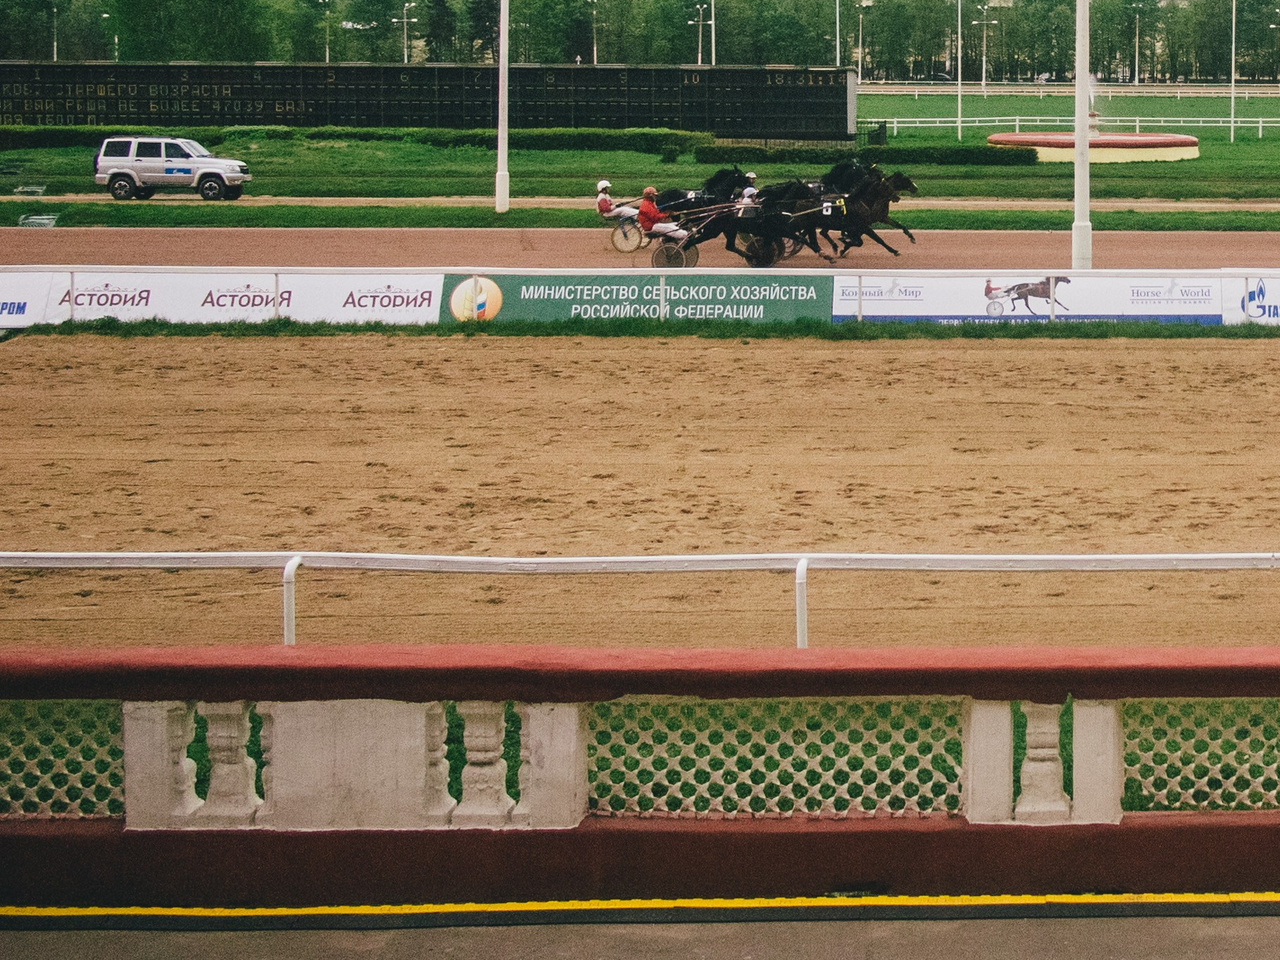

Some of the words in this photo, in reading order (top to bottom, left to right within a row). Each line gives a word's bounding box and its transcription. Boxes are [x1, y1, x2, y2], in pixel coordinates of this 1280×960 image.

[149, 84, 232, 96] ВОЗРАСТА
[520, 285, 639, 300] МИНИСТЕРСТВО
[643, 285, 727, 300] СЕЛЬСКОГО
[730, 283, 817, 300] ХОЗЯЙСТВА
[898, 288, 922, 298] Мир
[1131, 288, 1162, 298] Horse
[1180, 288, 1211, 298] World
[0, 301, 27, 315] РОМ
[571, 301, 670, 319] РОССИЙСКОЙ
[674, 304, 764, 320] ФЕДЕРАЦИИ
